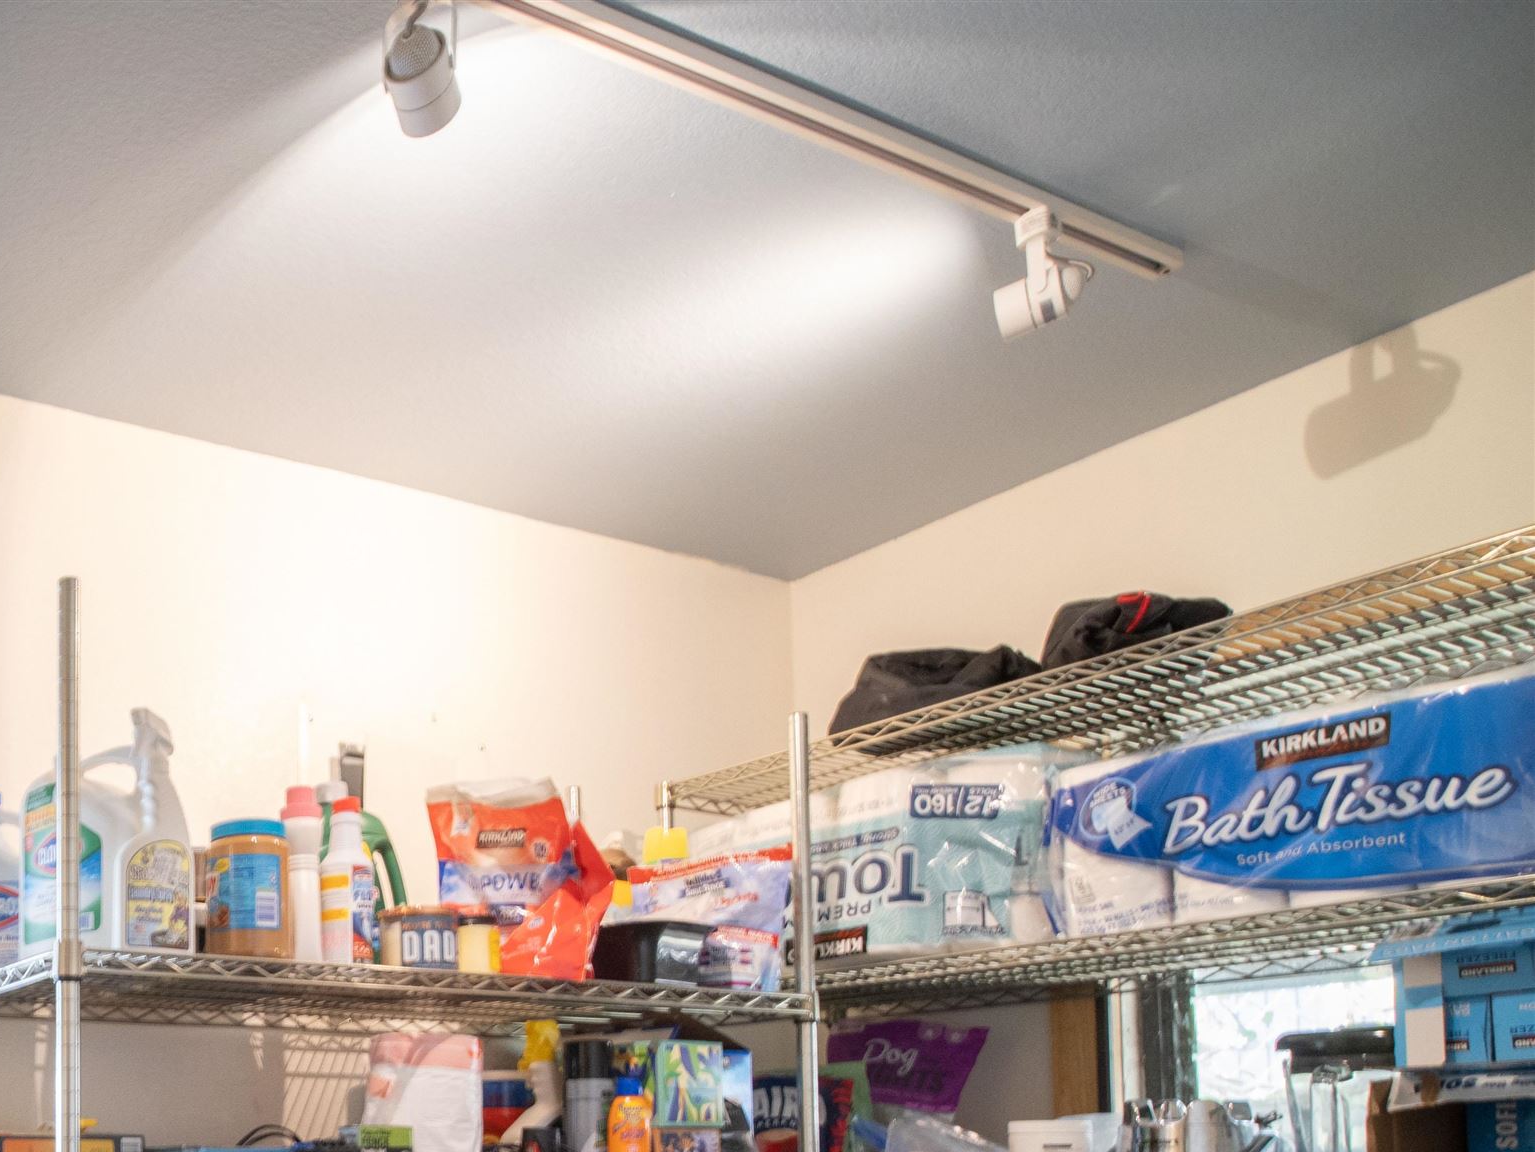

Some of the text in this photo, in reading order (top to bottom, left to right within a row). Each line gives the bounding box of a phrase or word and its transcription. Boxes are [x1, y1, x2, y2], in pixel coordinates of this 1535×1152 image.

[1261, 716, 1387, 758] KIRKLAND
[1164, 763, 1513, 854] Bath Tissue
[1237, 833, 1405, 867] Soft and Absorbent
[402, 929, 456, 963] DAD
[862, 1037, 919, 1077] Dog
[1495, 1101, 1519, 1150] SOFI
